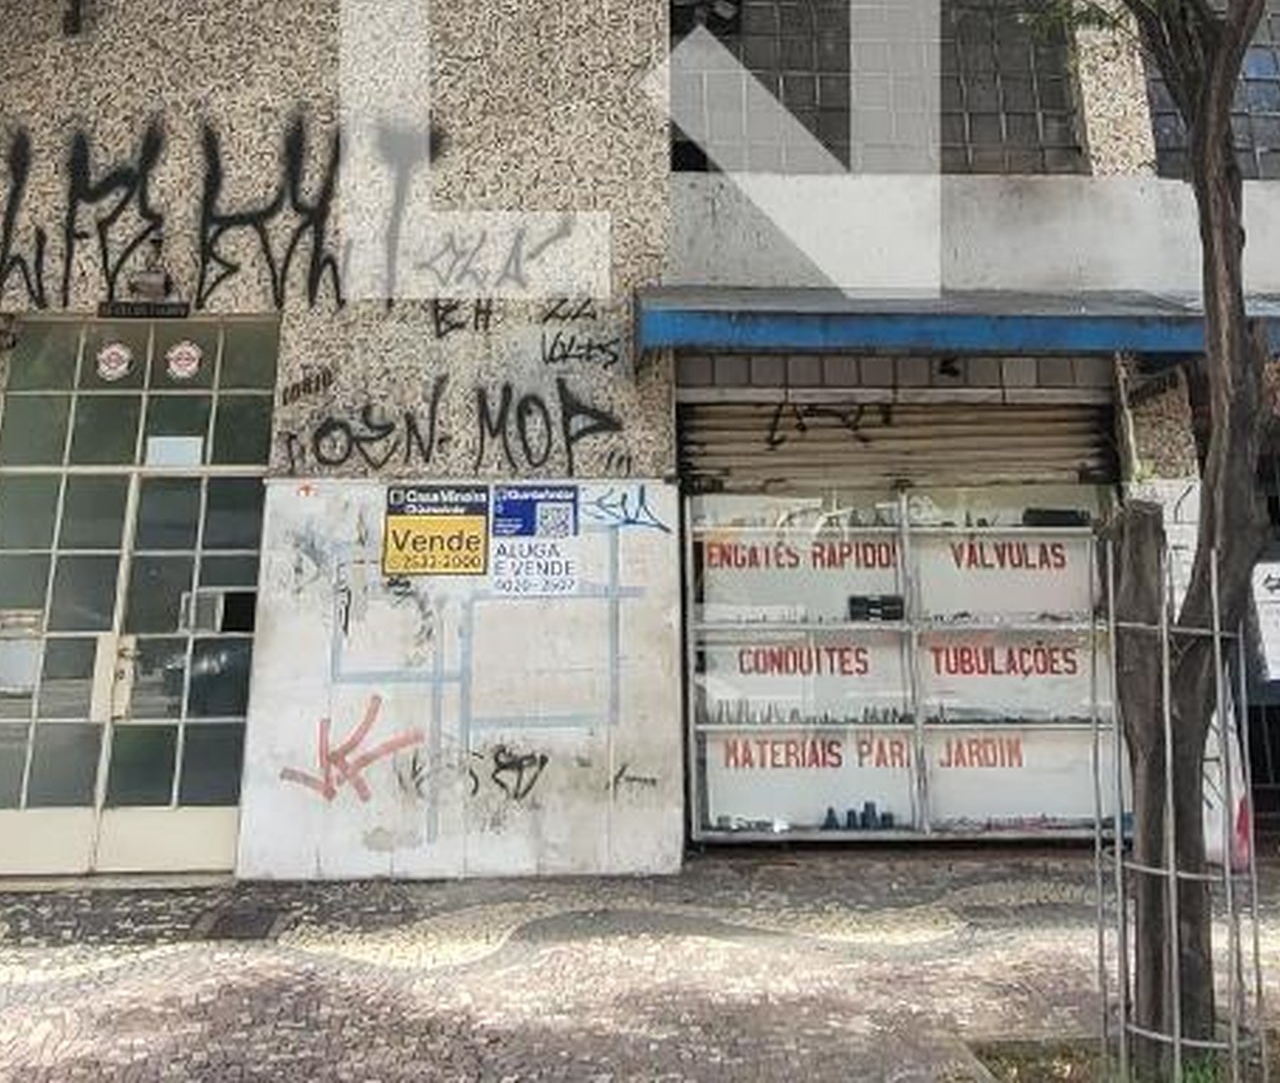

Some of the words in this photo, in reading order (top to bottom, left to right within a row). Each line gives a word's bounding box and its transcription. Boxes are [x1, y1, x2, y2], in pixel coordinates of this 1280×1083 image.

[391, 529, 481, 552] Vende
[495, 542, 561, 558] ALUGA
[508, 560, 575, 576] VENDE
[738, 646, 869, 676] CONDUITES
[930, 641, 1079, 679] TUBULAÇÕES
[724, 738, 843, 768] MATERIAIS
[939, 737, 1024, 768] JARDIM
